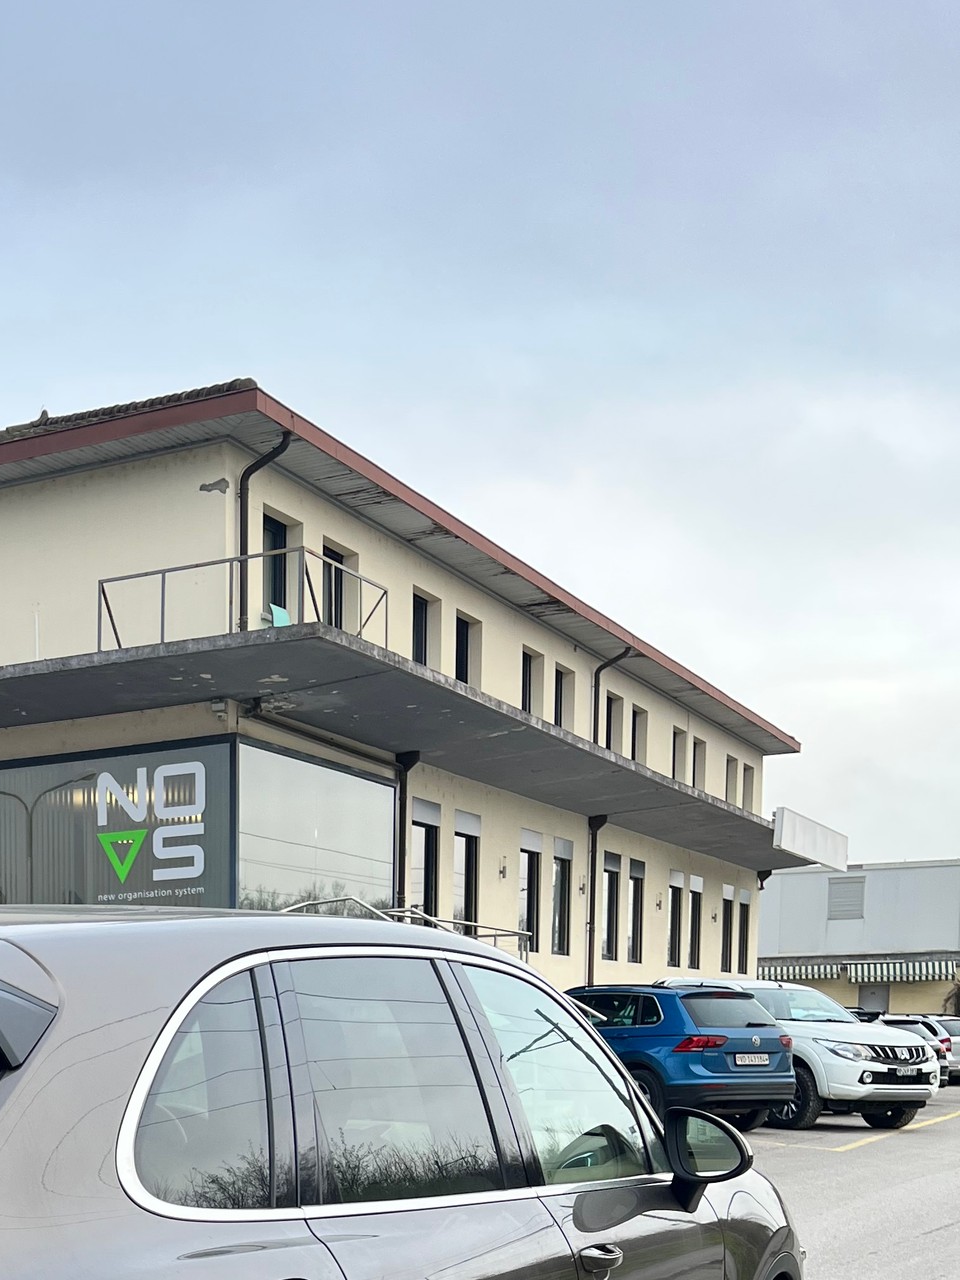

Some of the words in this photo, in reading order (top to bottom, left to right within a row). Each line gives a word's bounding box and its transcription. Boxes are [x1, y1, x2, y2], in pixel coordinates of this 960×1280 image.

[98, 893, 116, 902] new
[118, 889, 173, 902] organisation
[175, 886, 205, 898] system
